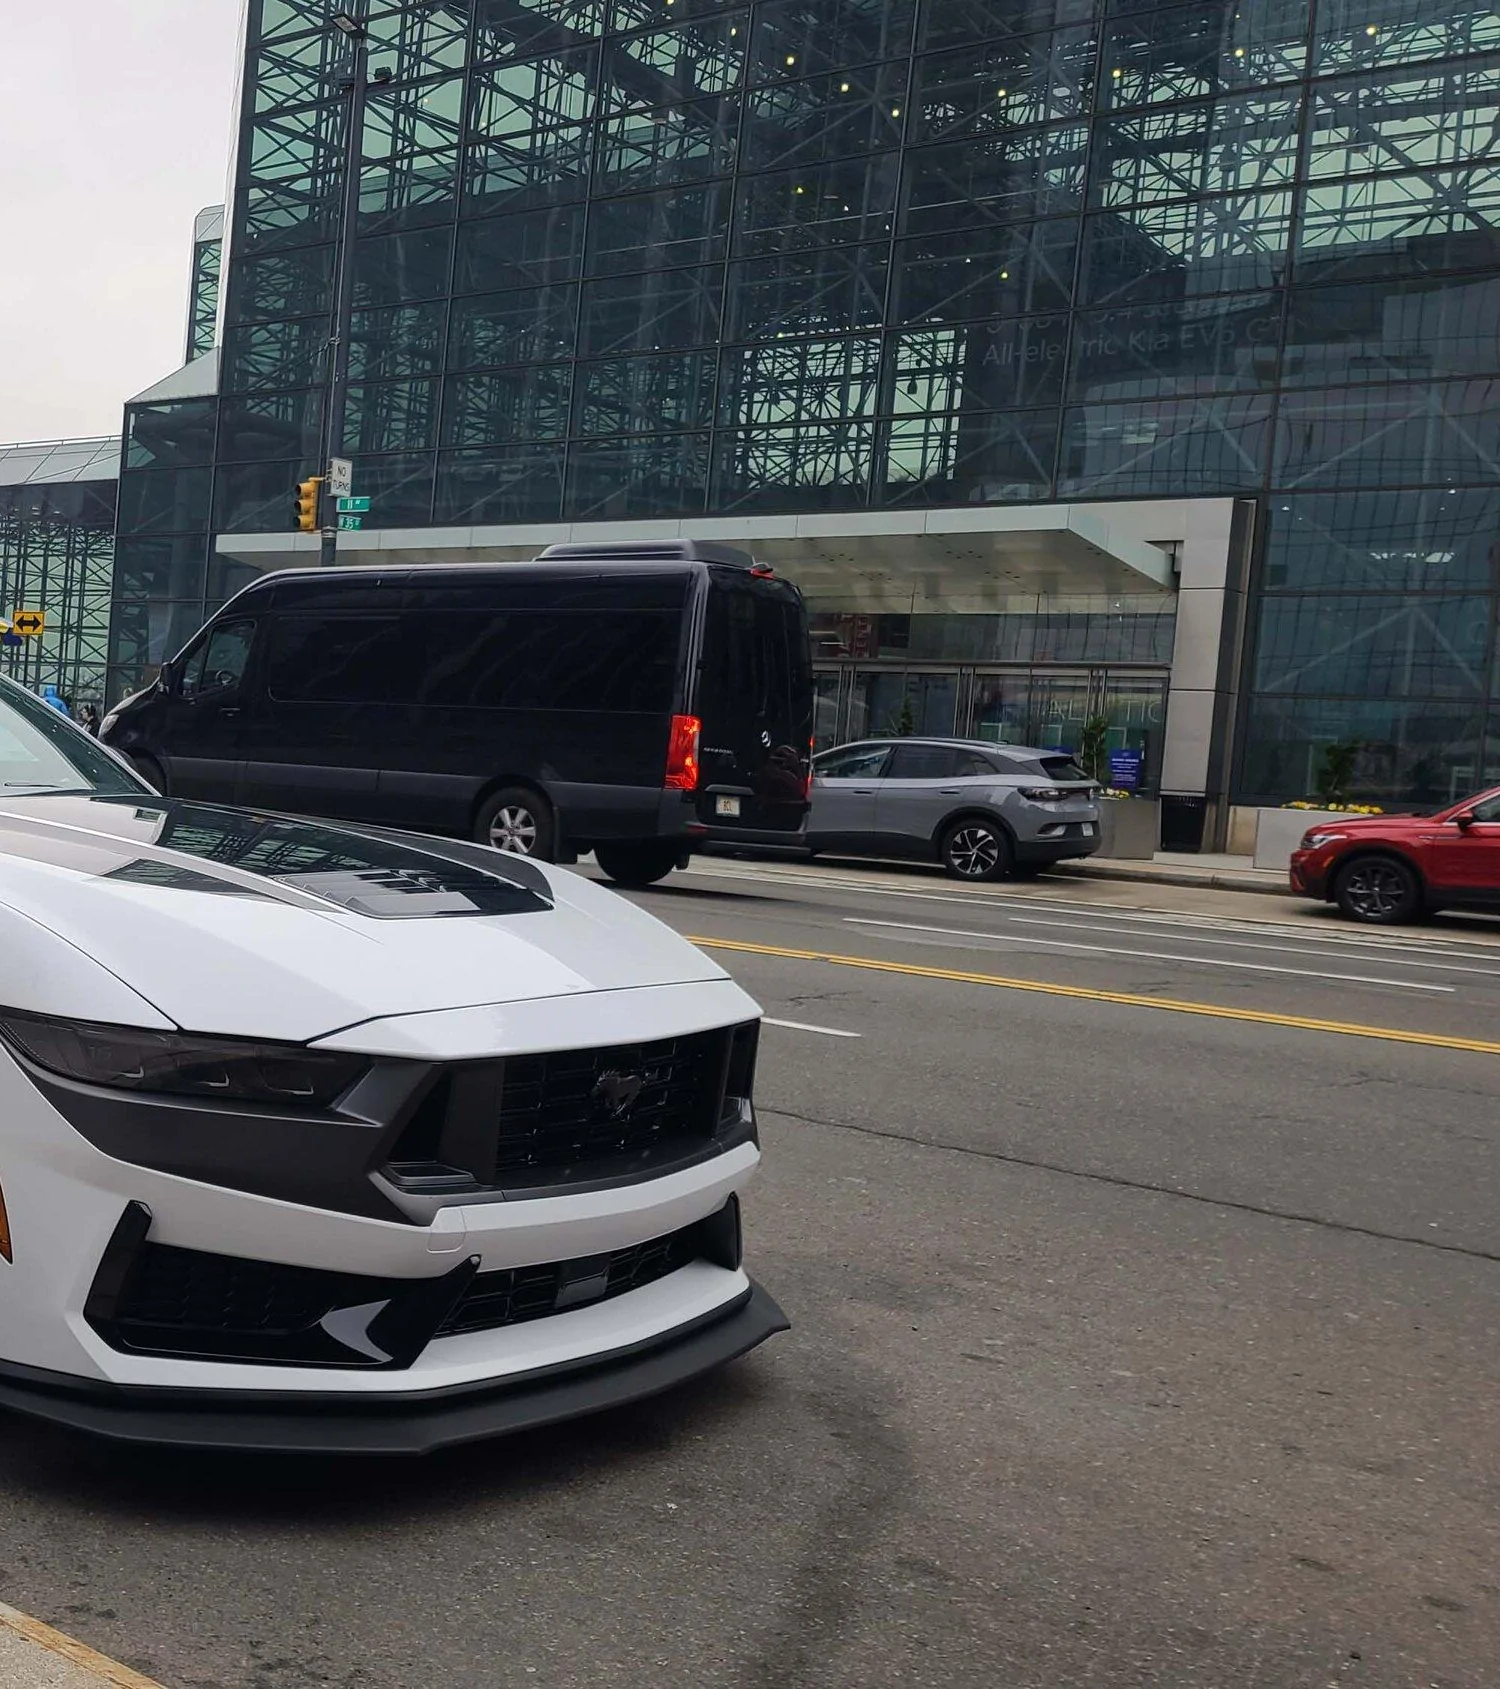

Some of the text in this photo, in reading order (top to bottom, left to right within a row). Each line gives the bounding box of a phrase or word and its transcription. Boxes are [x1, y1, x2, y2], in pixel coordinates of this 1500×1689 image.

[1128, 328, 1169, 353] Kia
[337, 466, 347, 477] NO
[333, 479, 350, 492] TURNS
[345, 518, 353, 529] 35
